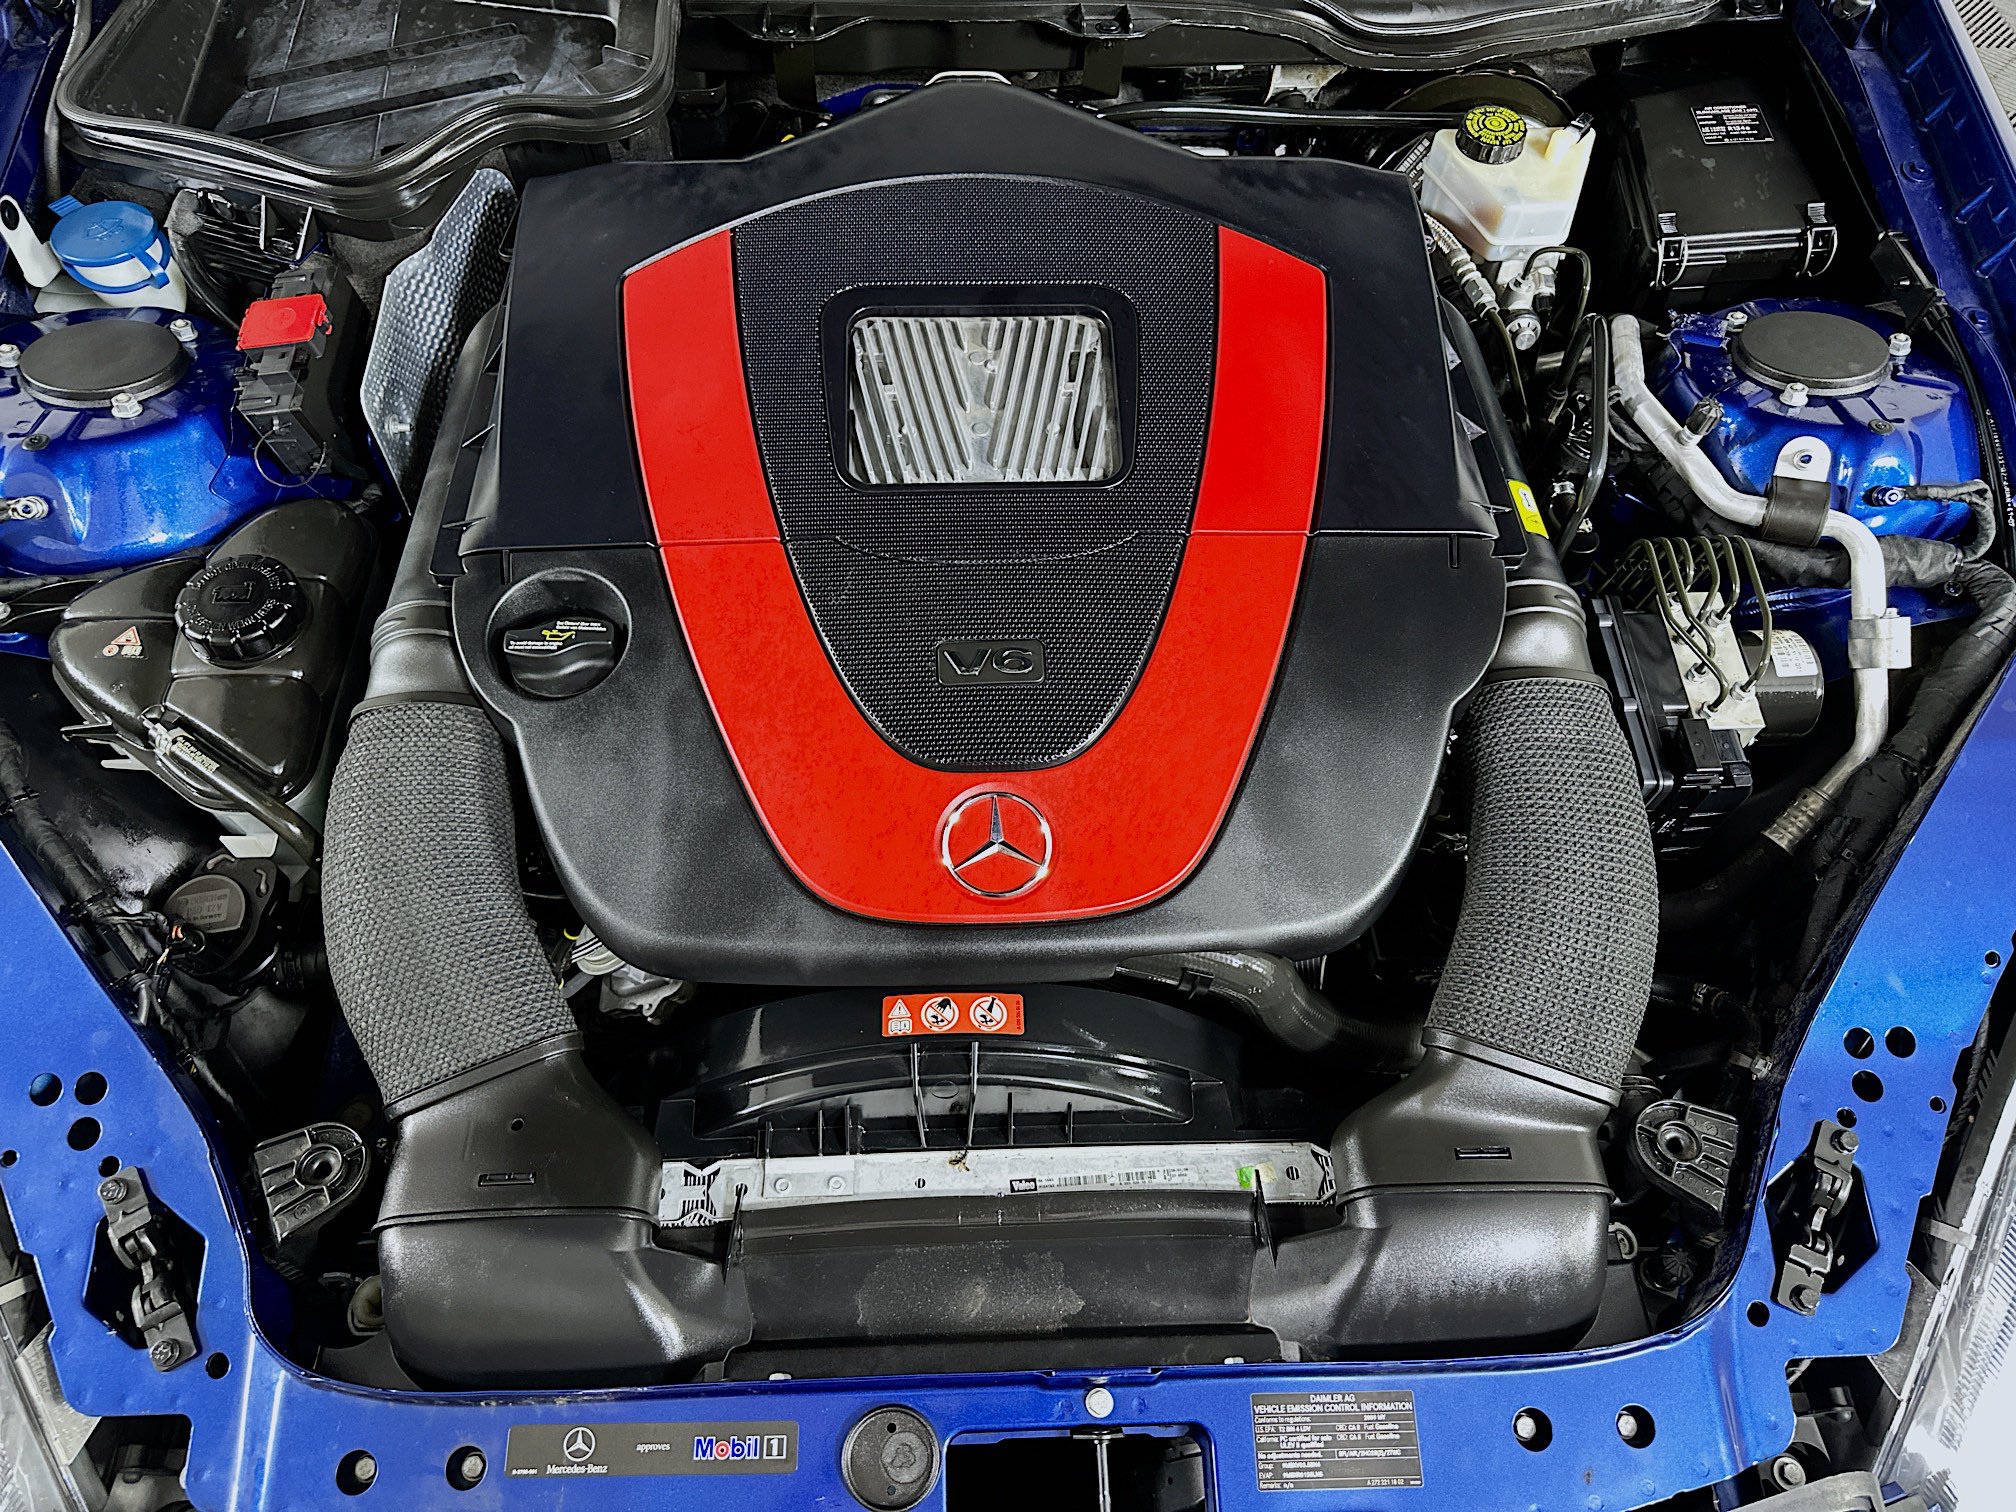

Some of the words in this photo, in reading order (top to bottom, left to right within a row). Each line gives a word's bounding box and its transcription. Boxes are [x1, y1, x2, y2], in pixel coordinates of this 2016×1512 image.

[943, 646, 1033, 675] V6
[1011, 1180, 1035, 1191] Valeo
[1310, 1394, 1343, 1403] DAIMLER
[1343, 1394, 1356, 1402] AG
[1254, 1405, 1286, 1414] VEHICLE
[1287, 1404, 1324, 1413] EMISSION
[1324, 1403, 1360, 1412] CONTROL
[1361, 1402, 1413, 1411] INFORMATION
[1255, 1416, 1278, 1424] Conforms
[636, 1442, 670, 1452] approves
[693, 1436, 760, 1460] Mobil
[546, 1463, 608, 1475] Mercedes-Benz
[1258, 1462, 1274, 1470] Group:
